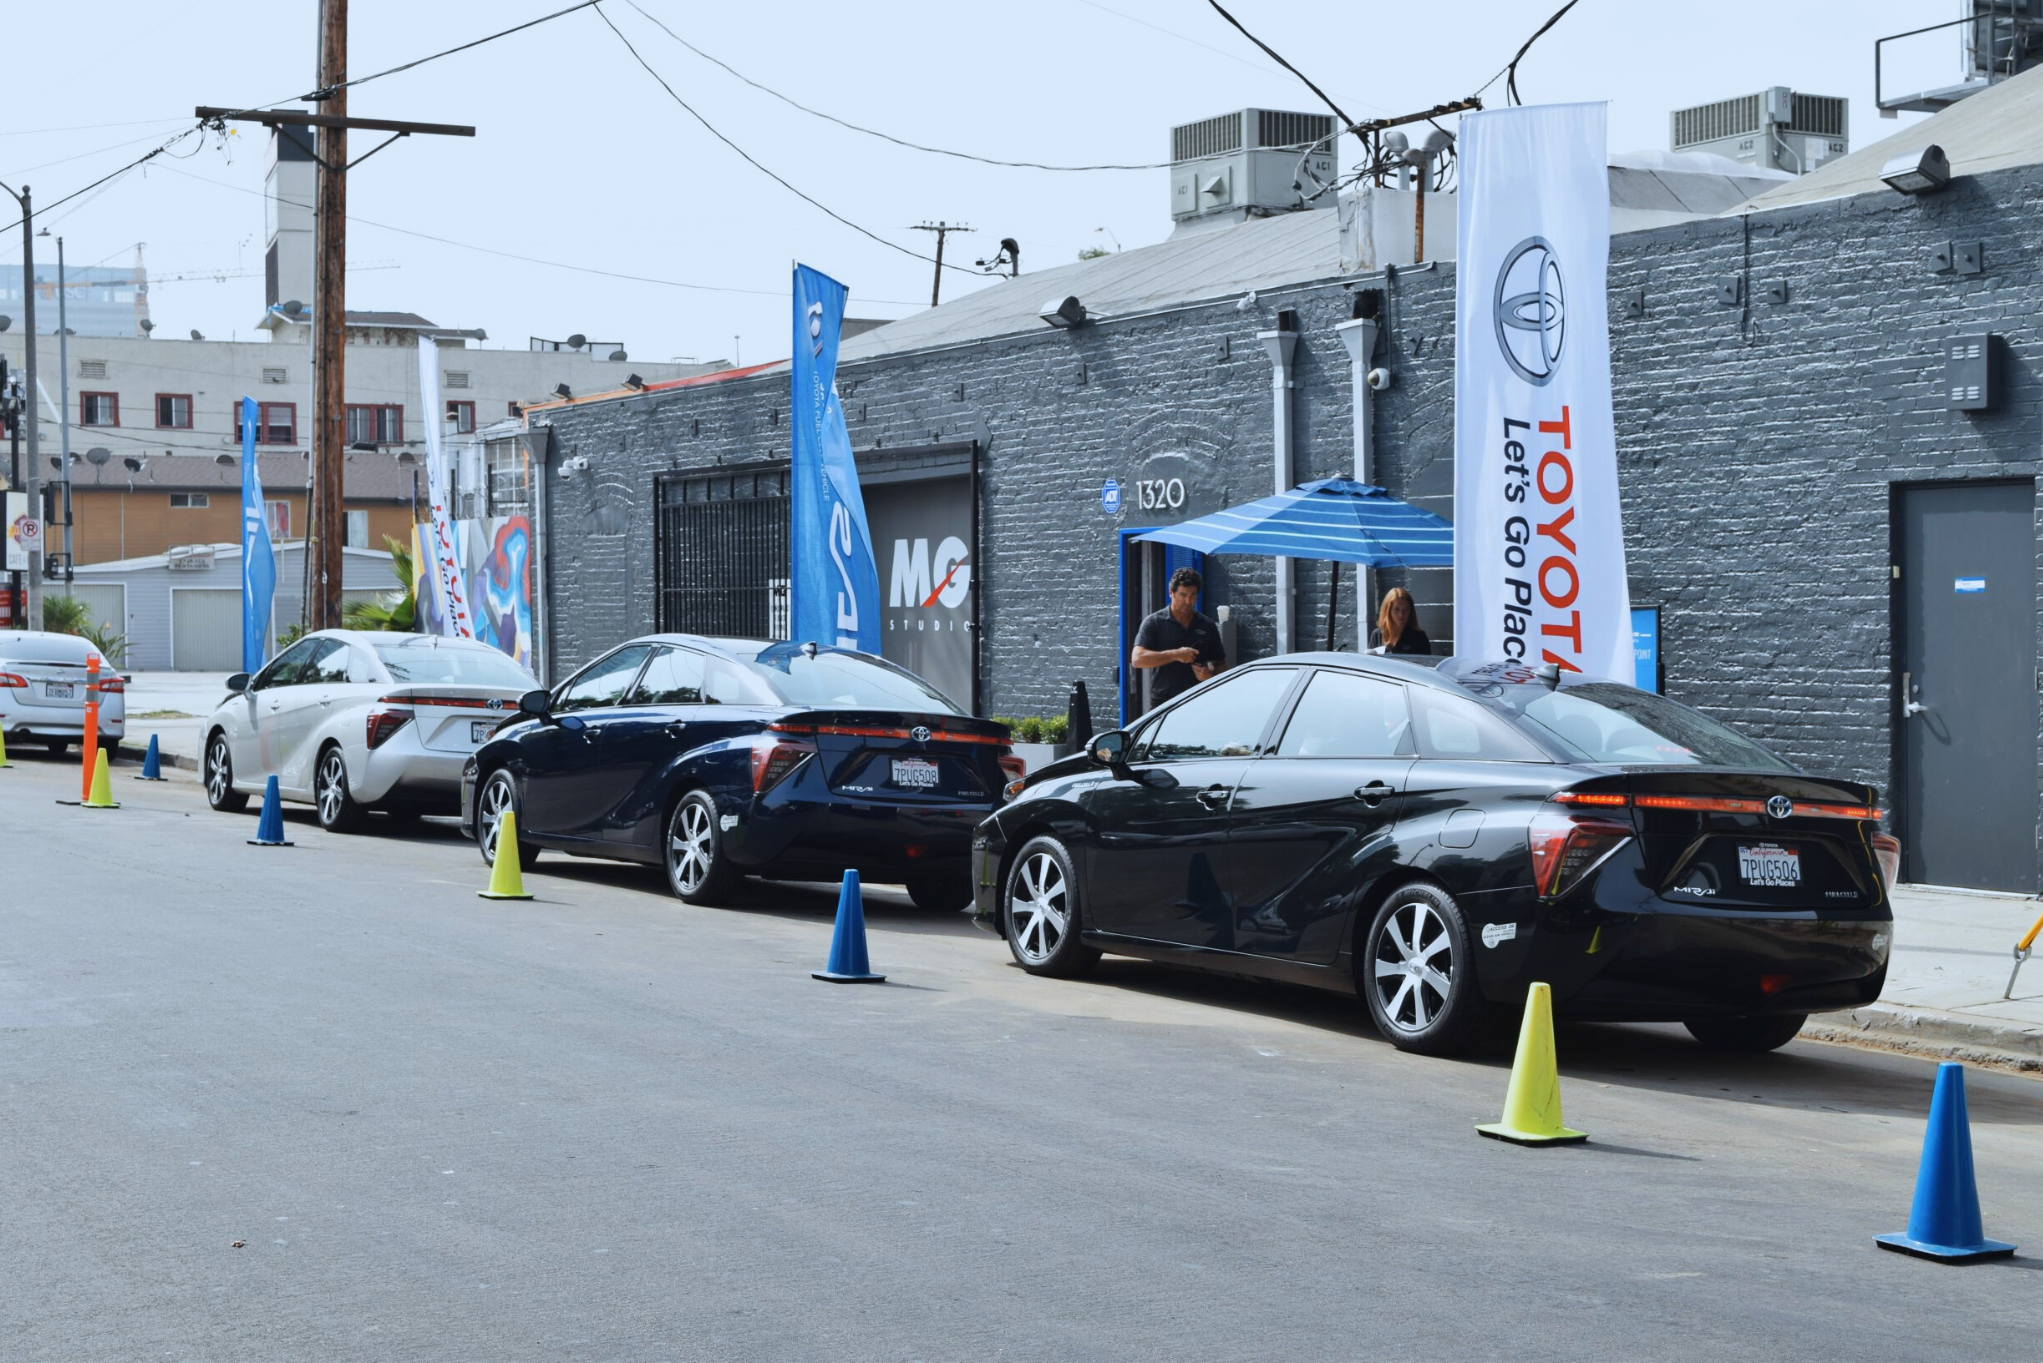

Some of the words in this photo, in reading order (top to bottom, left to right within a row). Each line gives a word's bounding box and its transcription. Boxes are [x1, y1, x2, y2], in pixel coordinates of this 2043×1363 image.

[1503, 417, 1531, 503] Let's
[1105, 490, 1118, 504] ADT
[1136, 478, 1185, 510] 1320
[1504, 516, 1530, 568] Go
[889, 536, 971, 609] MG
[1503, 577, 1533, 665] Plac
[894, 768, 938, 783] 7PUG508
[1741, 858, 1798, 880] 7PUG506
[1673, 886, 1716, 897] MIRAI
